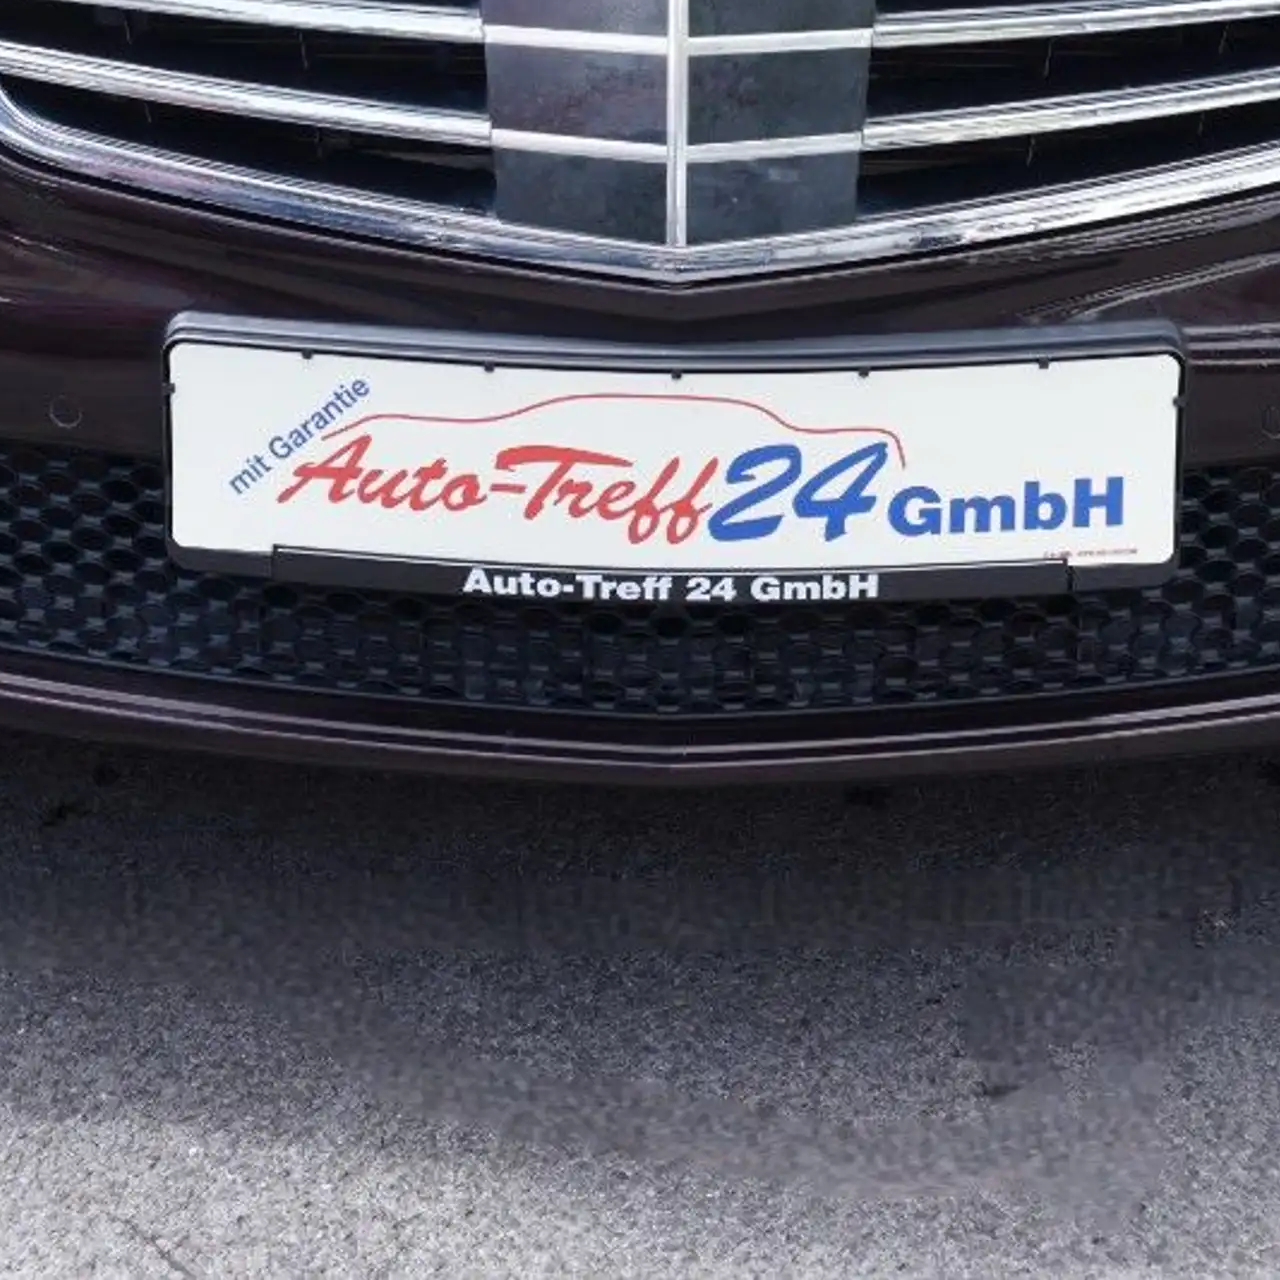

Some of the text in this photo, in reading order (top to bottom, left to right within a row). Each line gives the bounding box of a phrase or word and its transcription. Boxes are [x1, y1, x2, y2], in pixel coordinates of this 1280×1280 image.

[229, 378, 370, 495] mit Garantie
[887, 476, 1125, 537] GmbH
[463, 567, 879, 602] Auto-Treff 24 GmbH
